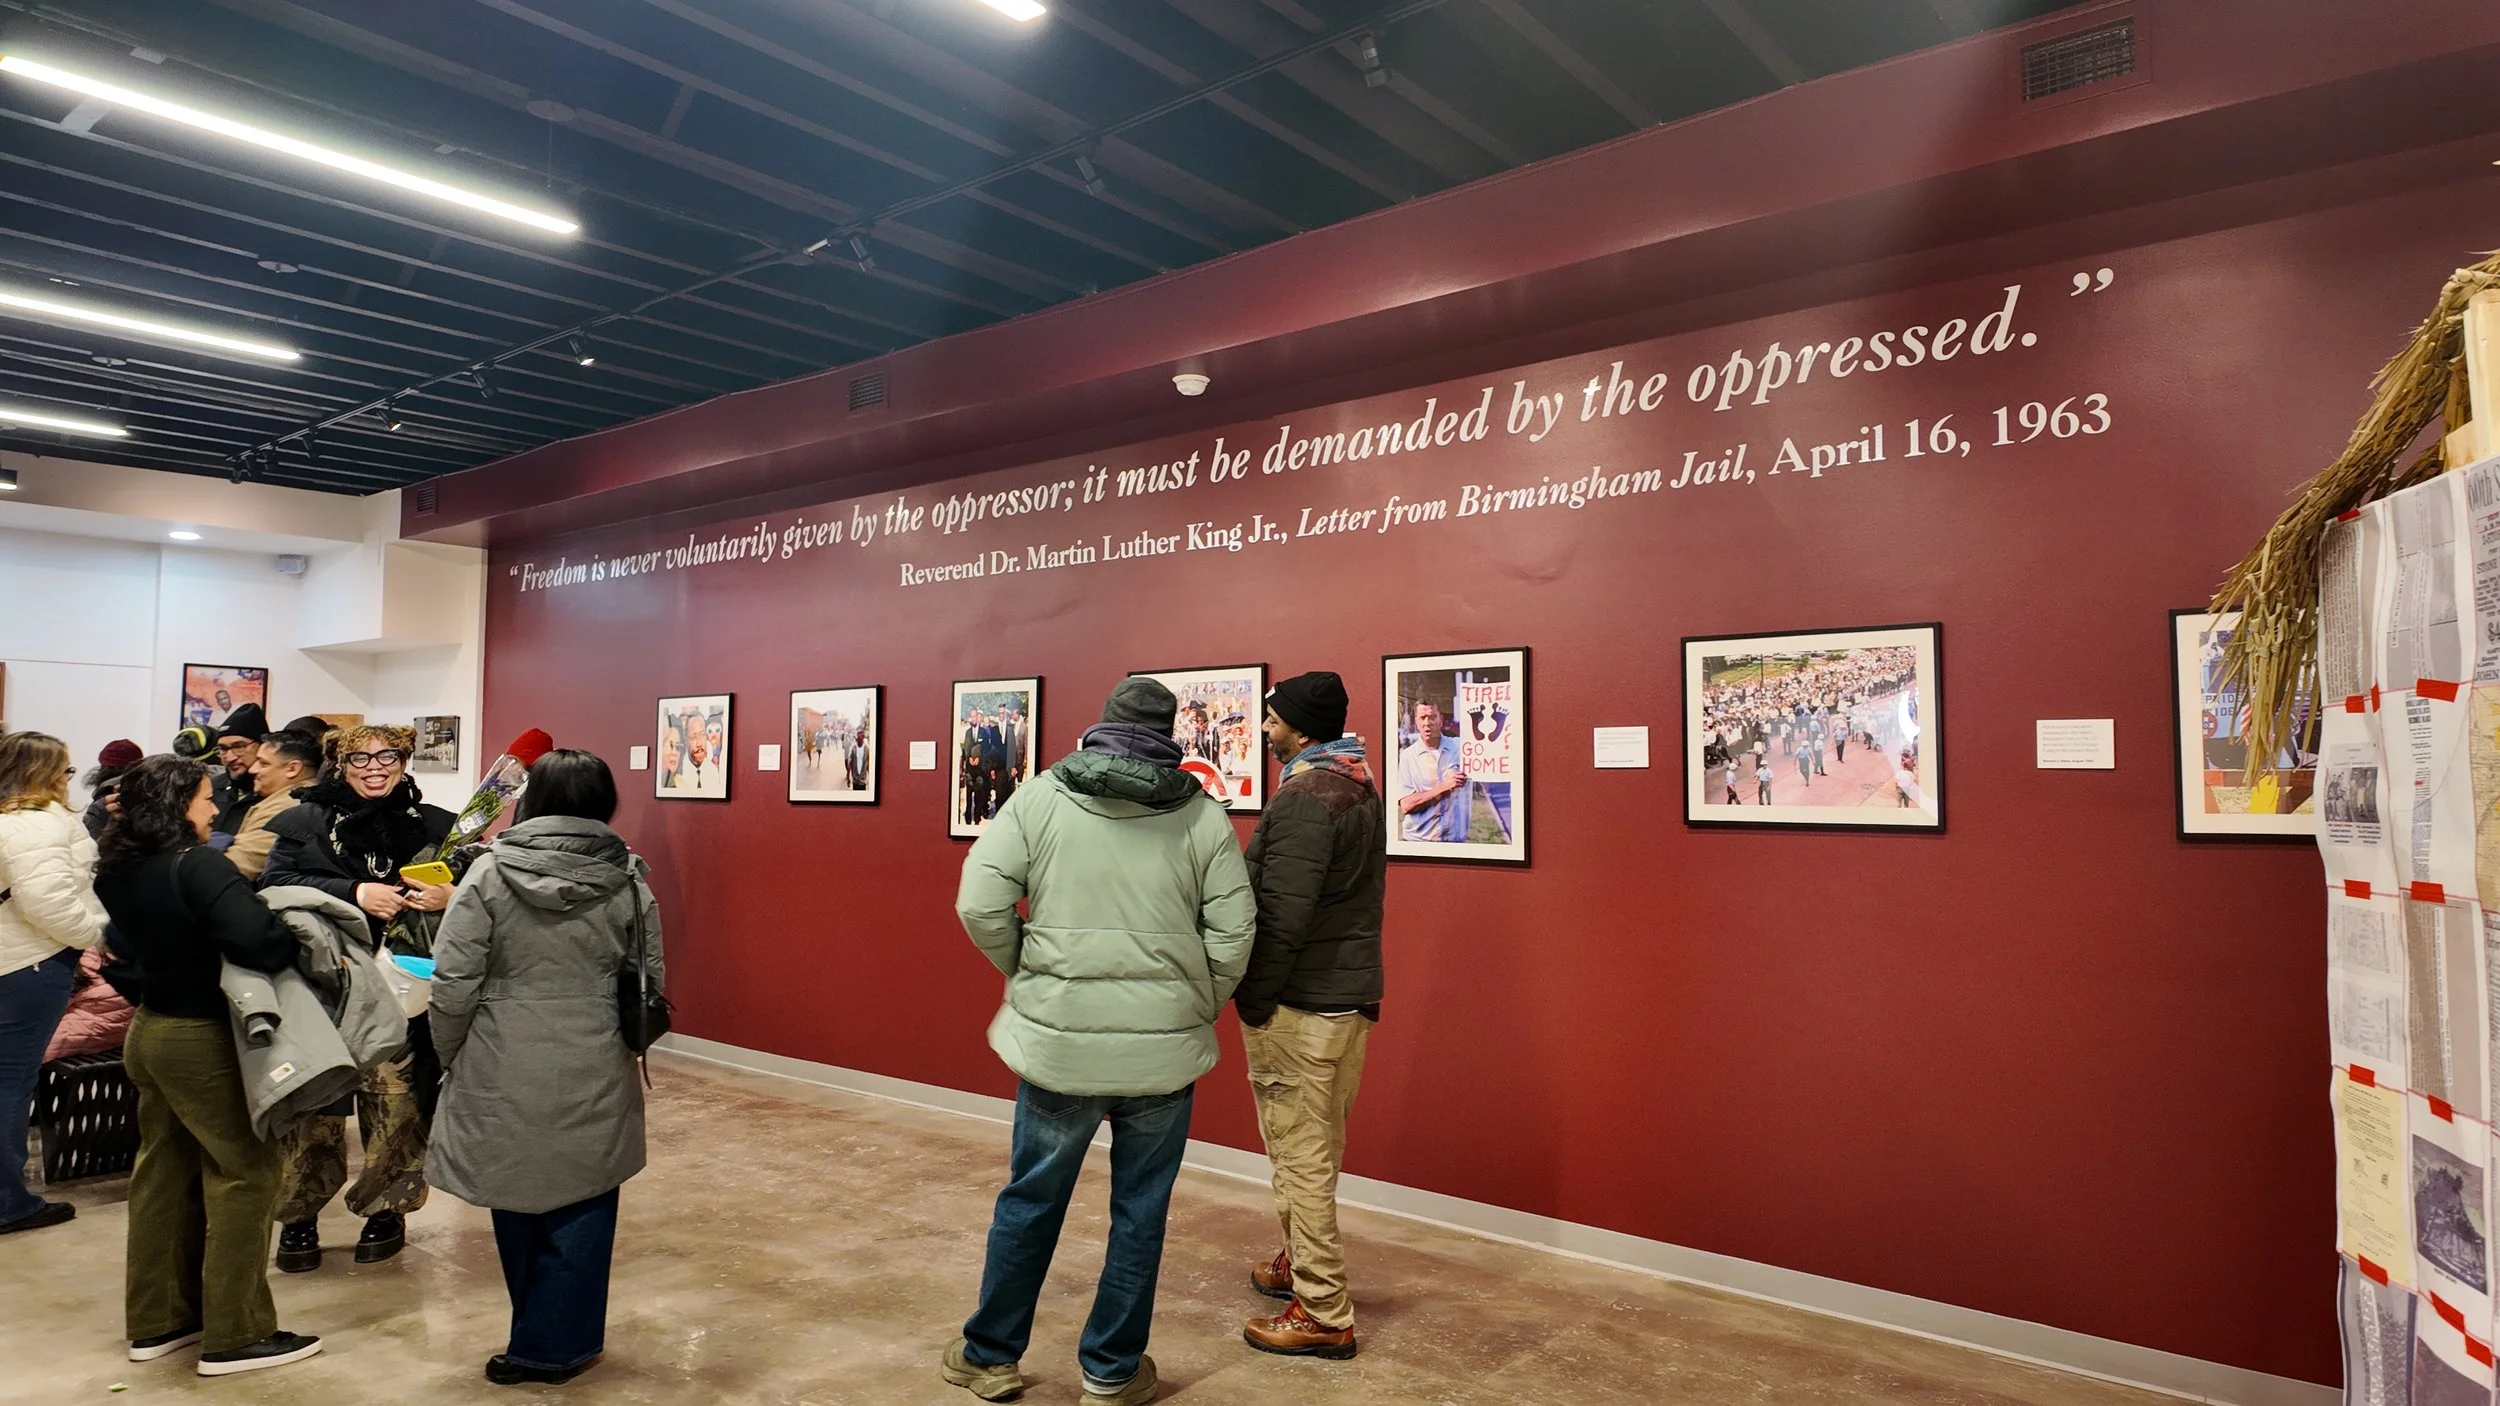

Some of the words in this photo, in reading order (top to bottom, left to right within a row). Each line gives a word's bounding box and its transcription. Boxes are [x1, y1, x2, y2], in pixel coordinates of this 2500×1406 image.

[590, 554, 606, 582] is
[609, 550, 662, 579] never
[665, 520, 778, 570] voluntarily
[780, 517, 844, 560] given
[850, 503, 878, 548] by
[884, 495, 925, 536] the
[931, 479, 1076, 535] oppressor;
[1082, 464, 1109, 504] it
[1116, 449, 1201, 498] must
[1209, 437, 1251, 483] be
[1262, 386, 1494, 475] demanded
[1506, 379, 1564, 443] by
[1580, 360, 1668, 422] the
[899, 552, 985, 587] Reverend
[989, 550, 1021, 575] Dr.
[1025, 539, 1097, 571] Martin
[1101, 530, 1181, 561] Luther
[1185, 521, 1243, 552] King
[1247, 514, 1288, 545] Jr.,
[1295, 507, 1377, 538] Letter
[1377, 495, 1448, 534] from
[1455, 465, 1663, 517] Birmingham
[1669, 443, 1756, 489] Jail,
[1767, 423, 1887, 479] April
[1903, 413, 1971, 458] 16,
[1991, 392, 2112, 447] 1963
[2205, 694, 2243, 704] PIDE
[1462, 741, 1484, 757] GO
[1462, 756, 1510, 774] HOME
